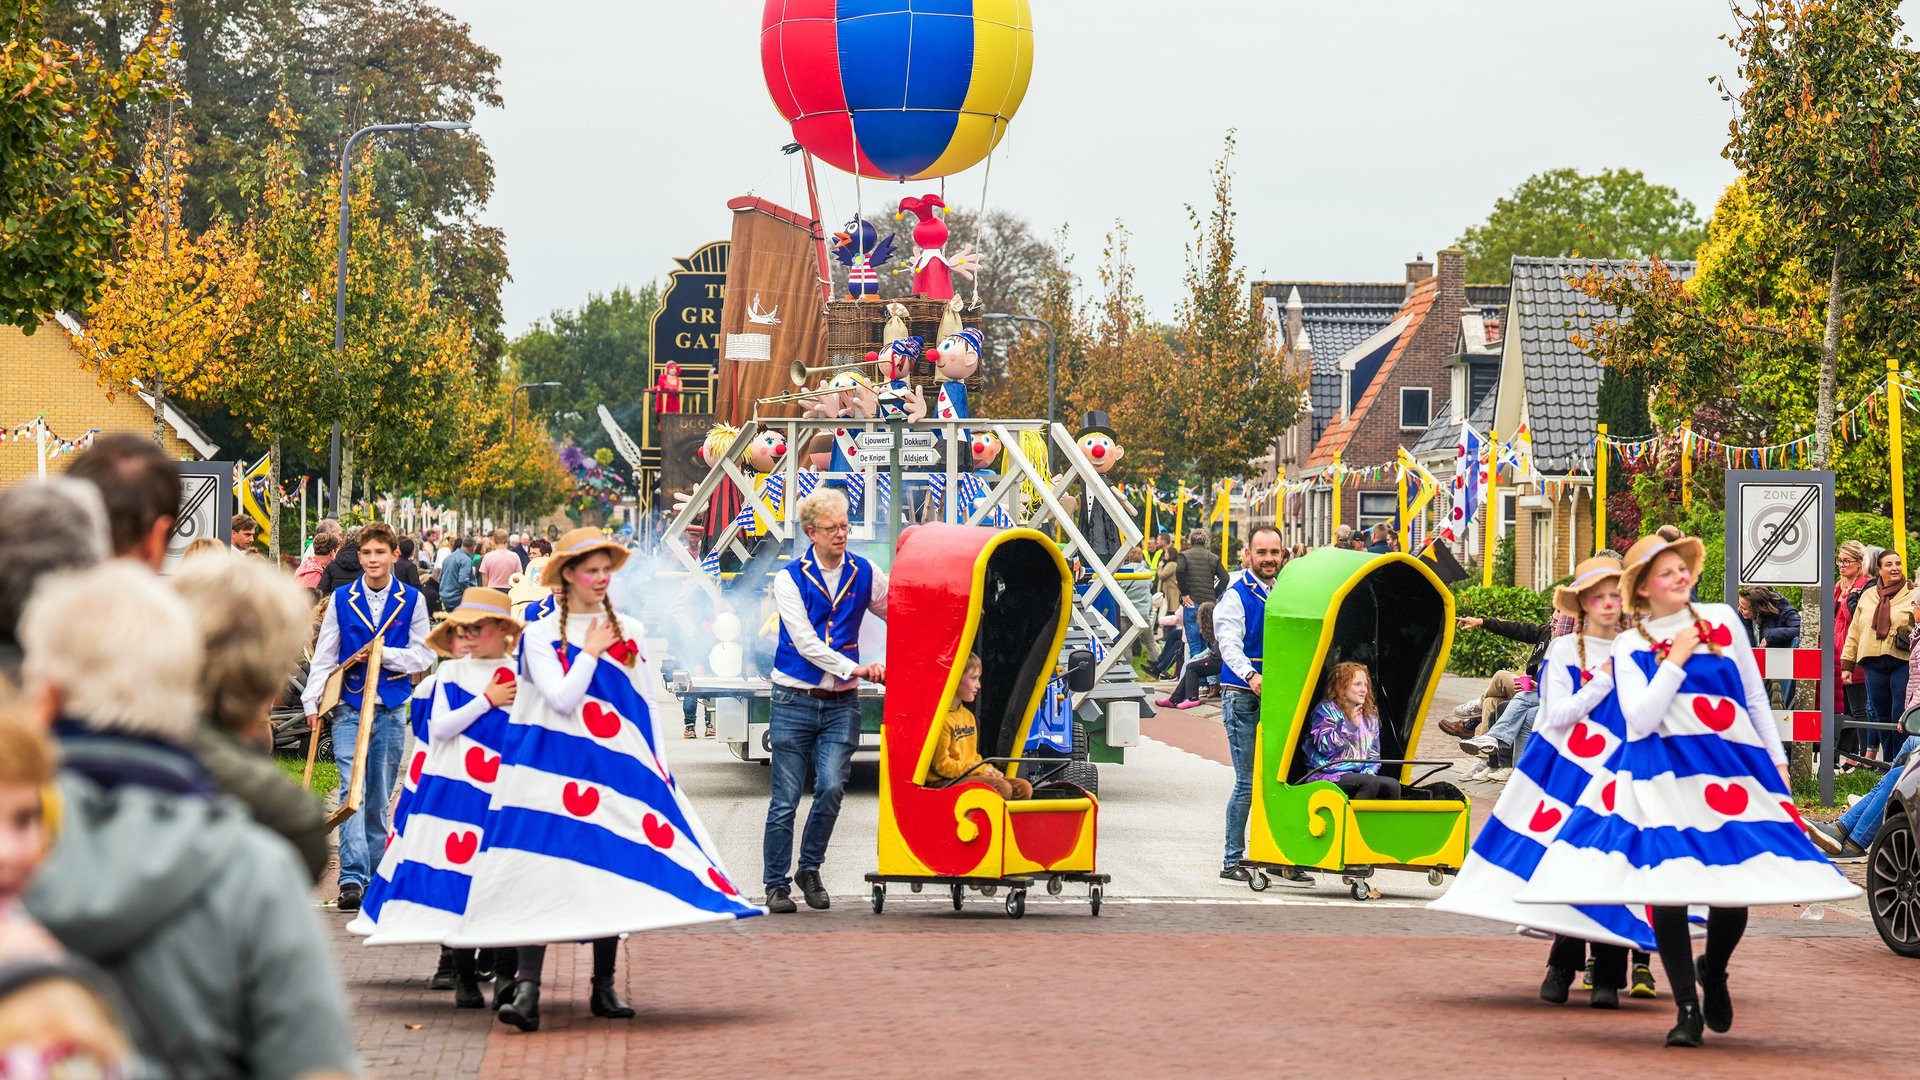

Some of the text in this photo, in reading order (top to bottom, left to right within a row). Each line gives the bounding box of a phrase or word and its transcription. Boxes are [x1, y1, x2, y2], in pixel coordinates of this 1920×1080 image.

[681, 307, 723, 324] GR
[864, 436, 890, 445] Ljouwert
[904, 437, 928, 446] Dokkum
[860, 453, 886, 463] De Knipe
[903, 454, 929, 464] Aldsjerk
[1763, 490, 1797, 500] ZONE
[1762, 522, 1800, 546] 30
